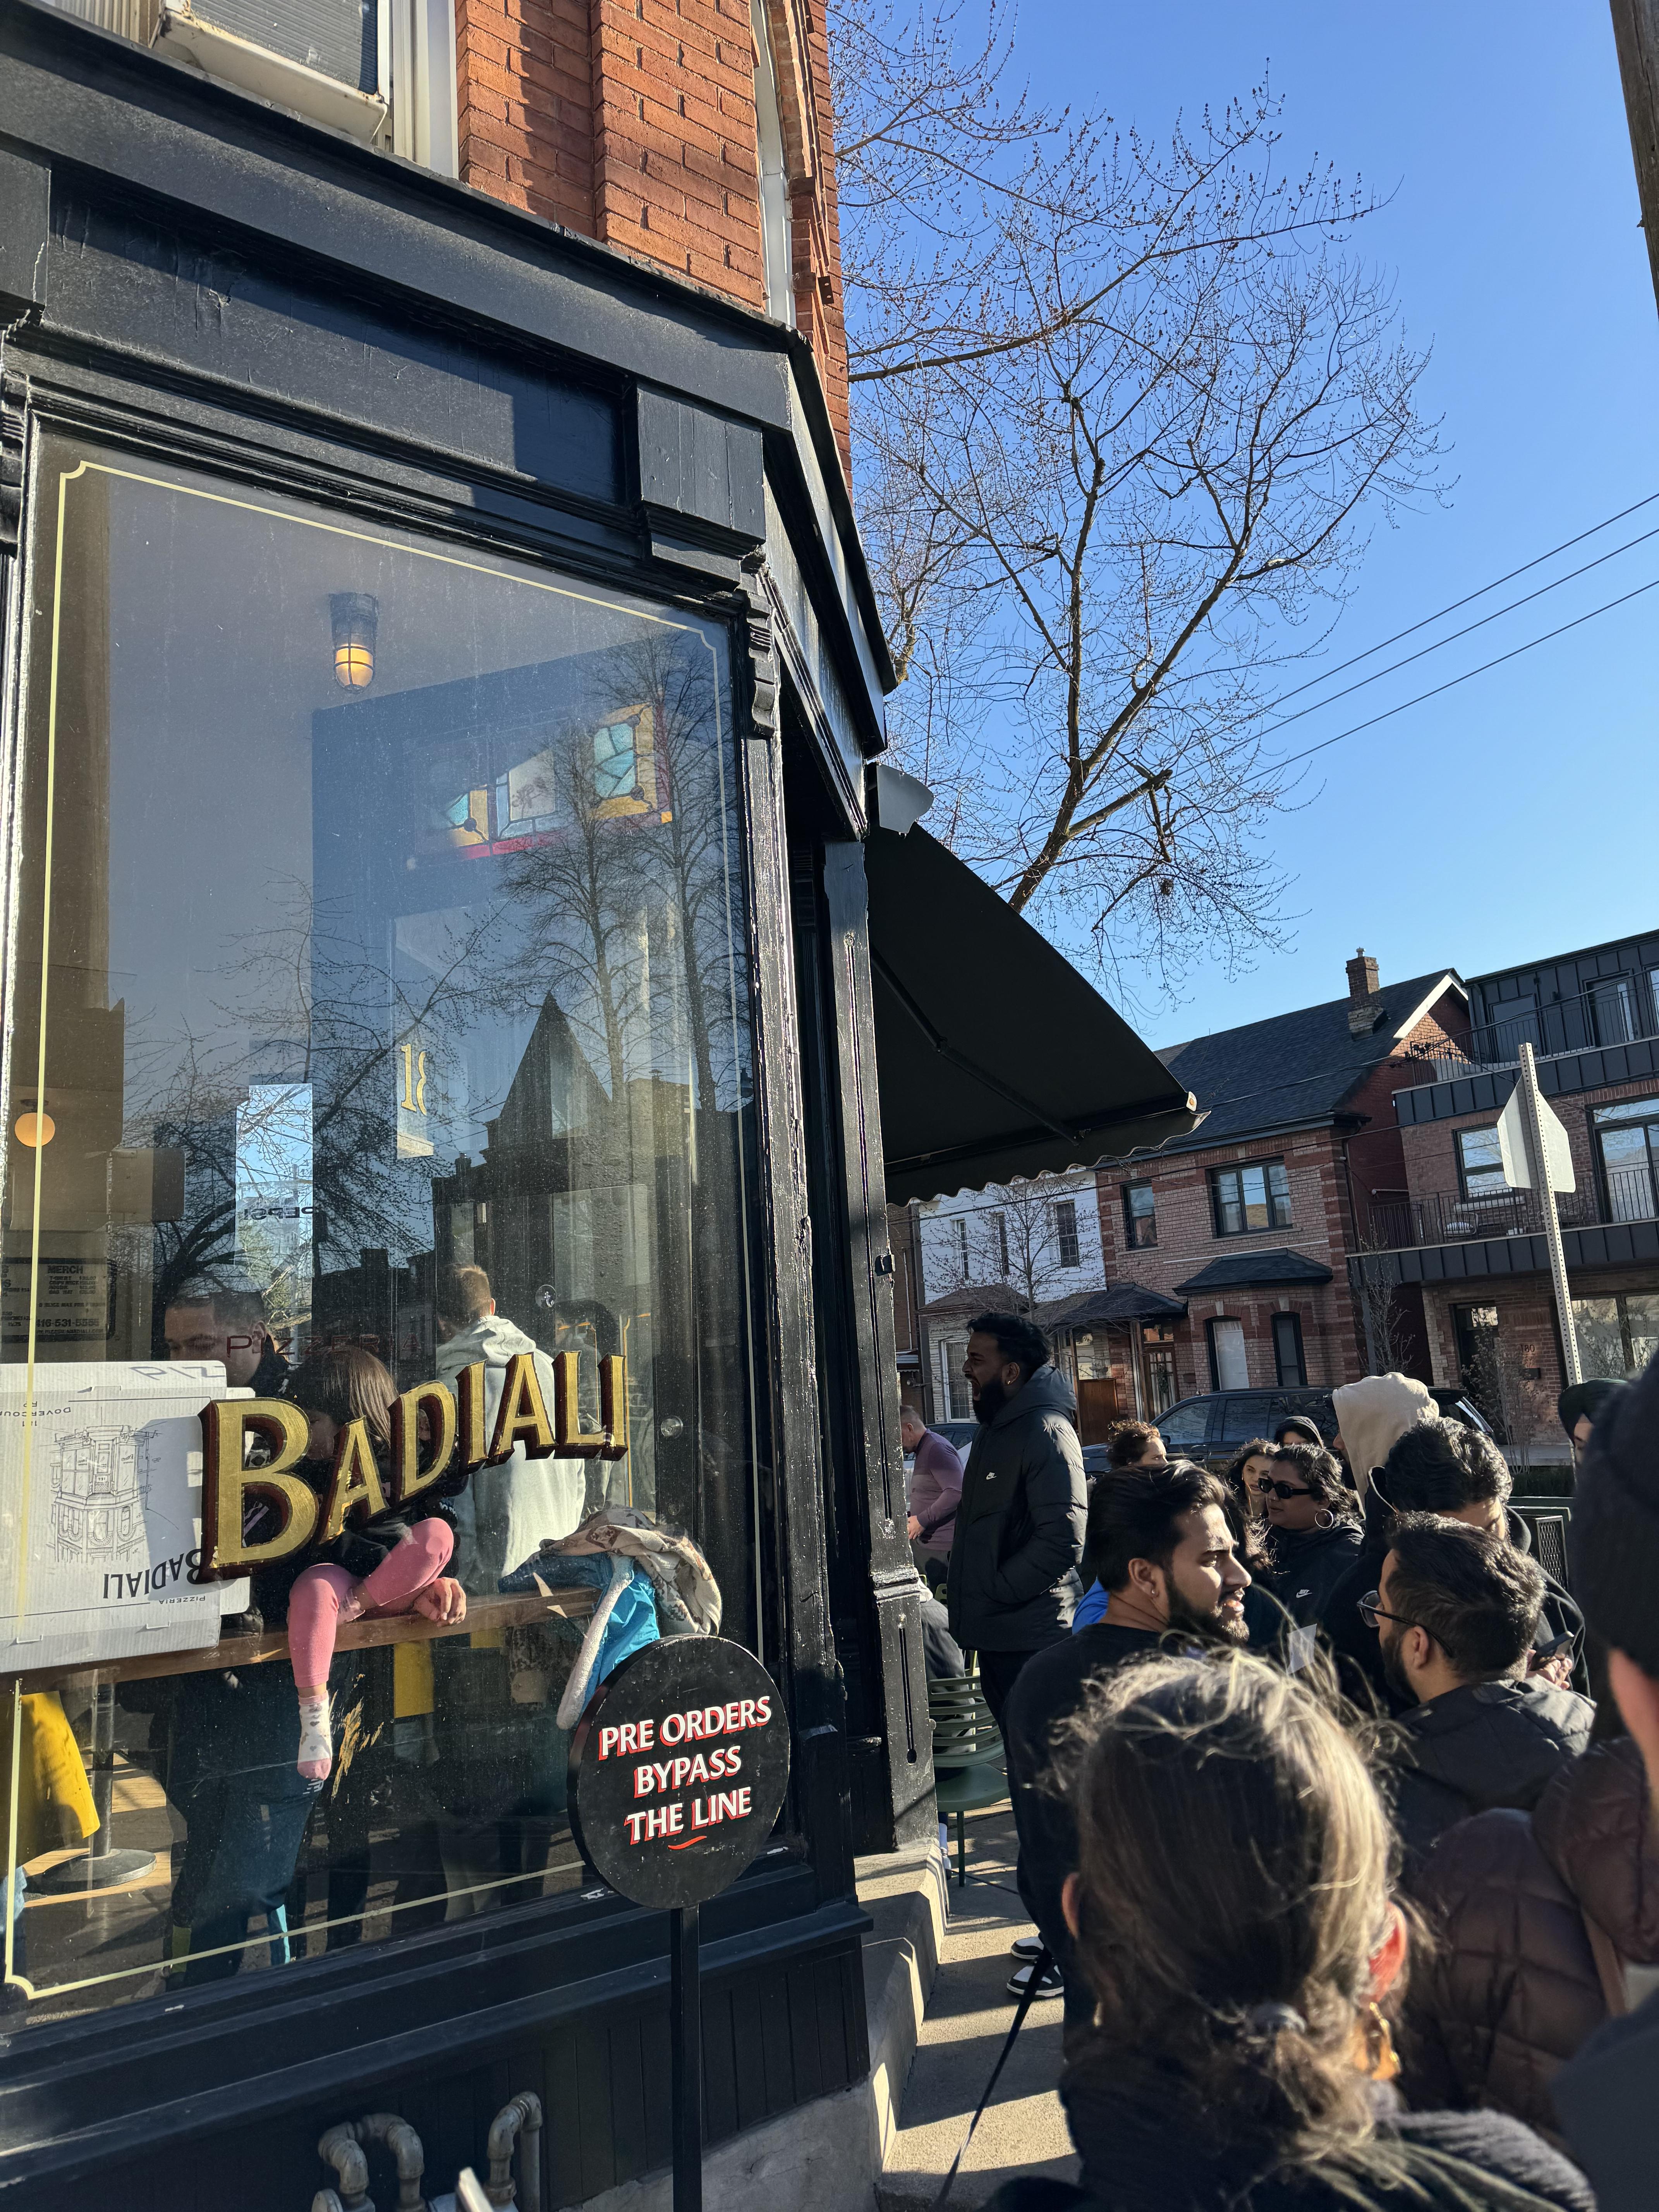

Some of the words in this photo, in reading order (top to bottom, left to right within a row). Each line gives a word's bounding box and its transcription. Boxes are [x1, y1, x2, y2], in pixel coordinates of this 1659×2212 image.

[47, 1266, 83, 1274] MERCH
[227, 1333, 421, 1357] PIZZERIA
[1520, 1344, 1535, 1353] 180
[198, 1351, 628, 1583] BADIALI
[103, 1548, 201, 1599] BADIALI
[158, 1595, 206, 1604] PIZZERIA
[599, 1719, 654, 1760] PRE
[660, 1696, 772, 1747] ORDERS
[634, 1745, 742, 1798] BYPASS
[624, 1803, 684, 1845] THE
[691, 1786, 752, 1830] LINE
